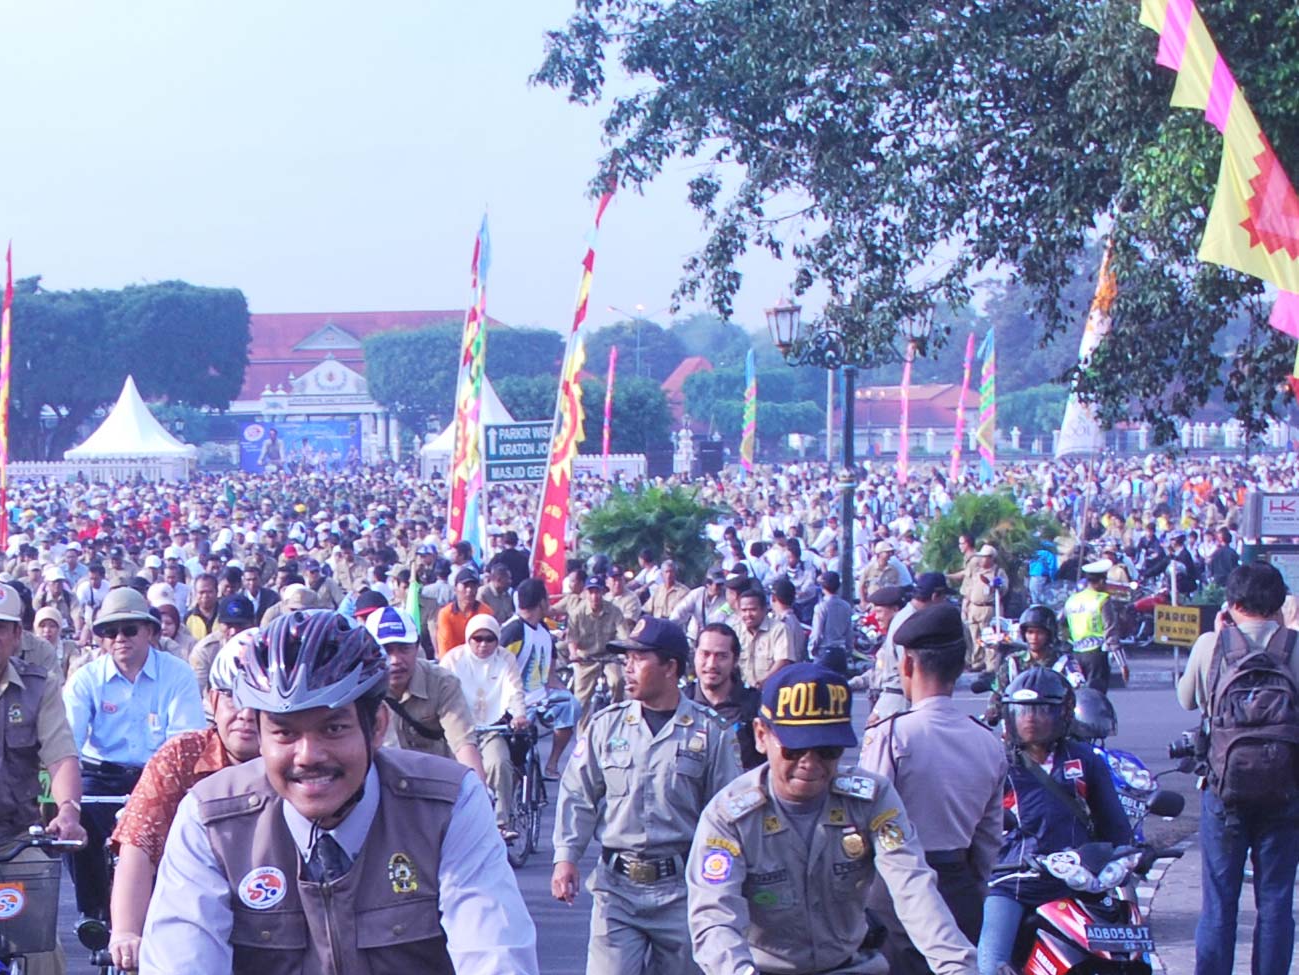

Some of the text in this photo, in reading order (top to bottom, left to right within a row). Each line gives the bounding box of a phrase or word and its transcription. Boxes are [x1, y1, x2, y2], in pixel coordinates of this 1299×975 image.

[498, 428, 531, 440] PARKIR
[499, 442, 549, 456] KRATON JO
[491, 466, 526, 480] MASJID
[1157, 611, 1198, 623] PARKIR
